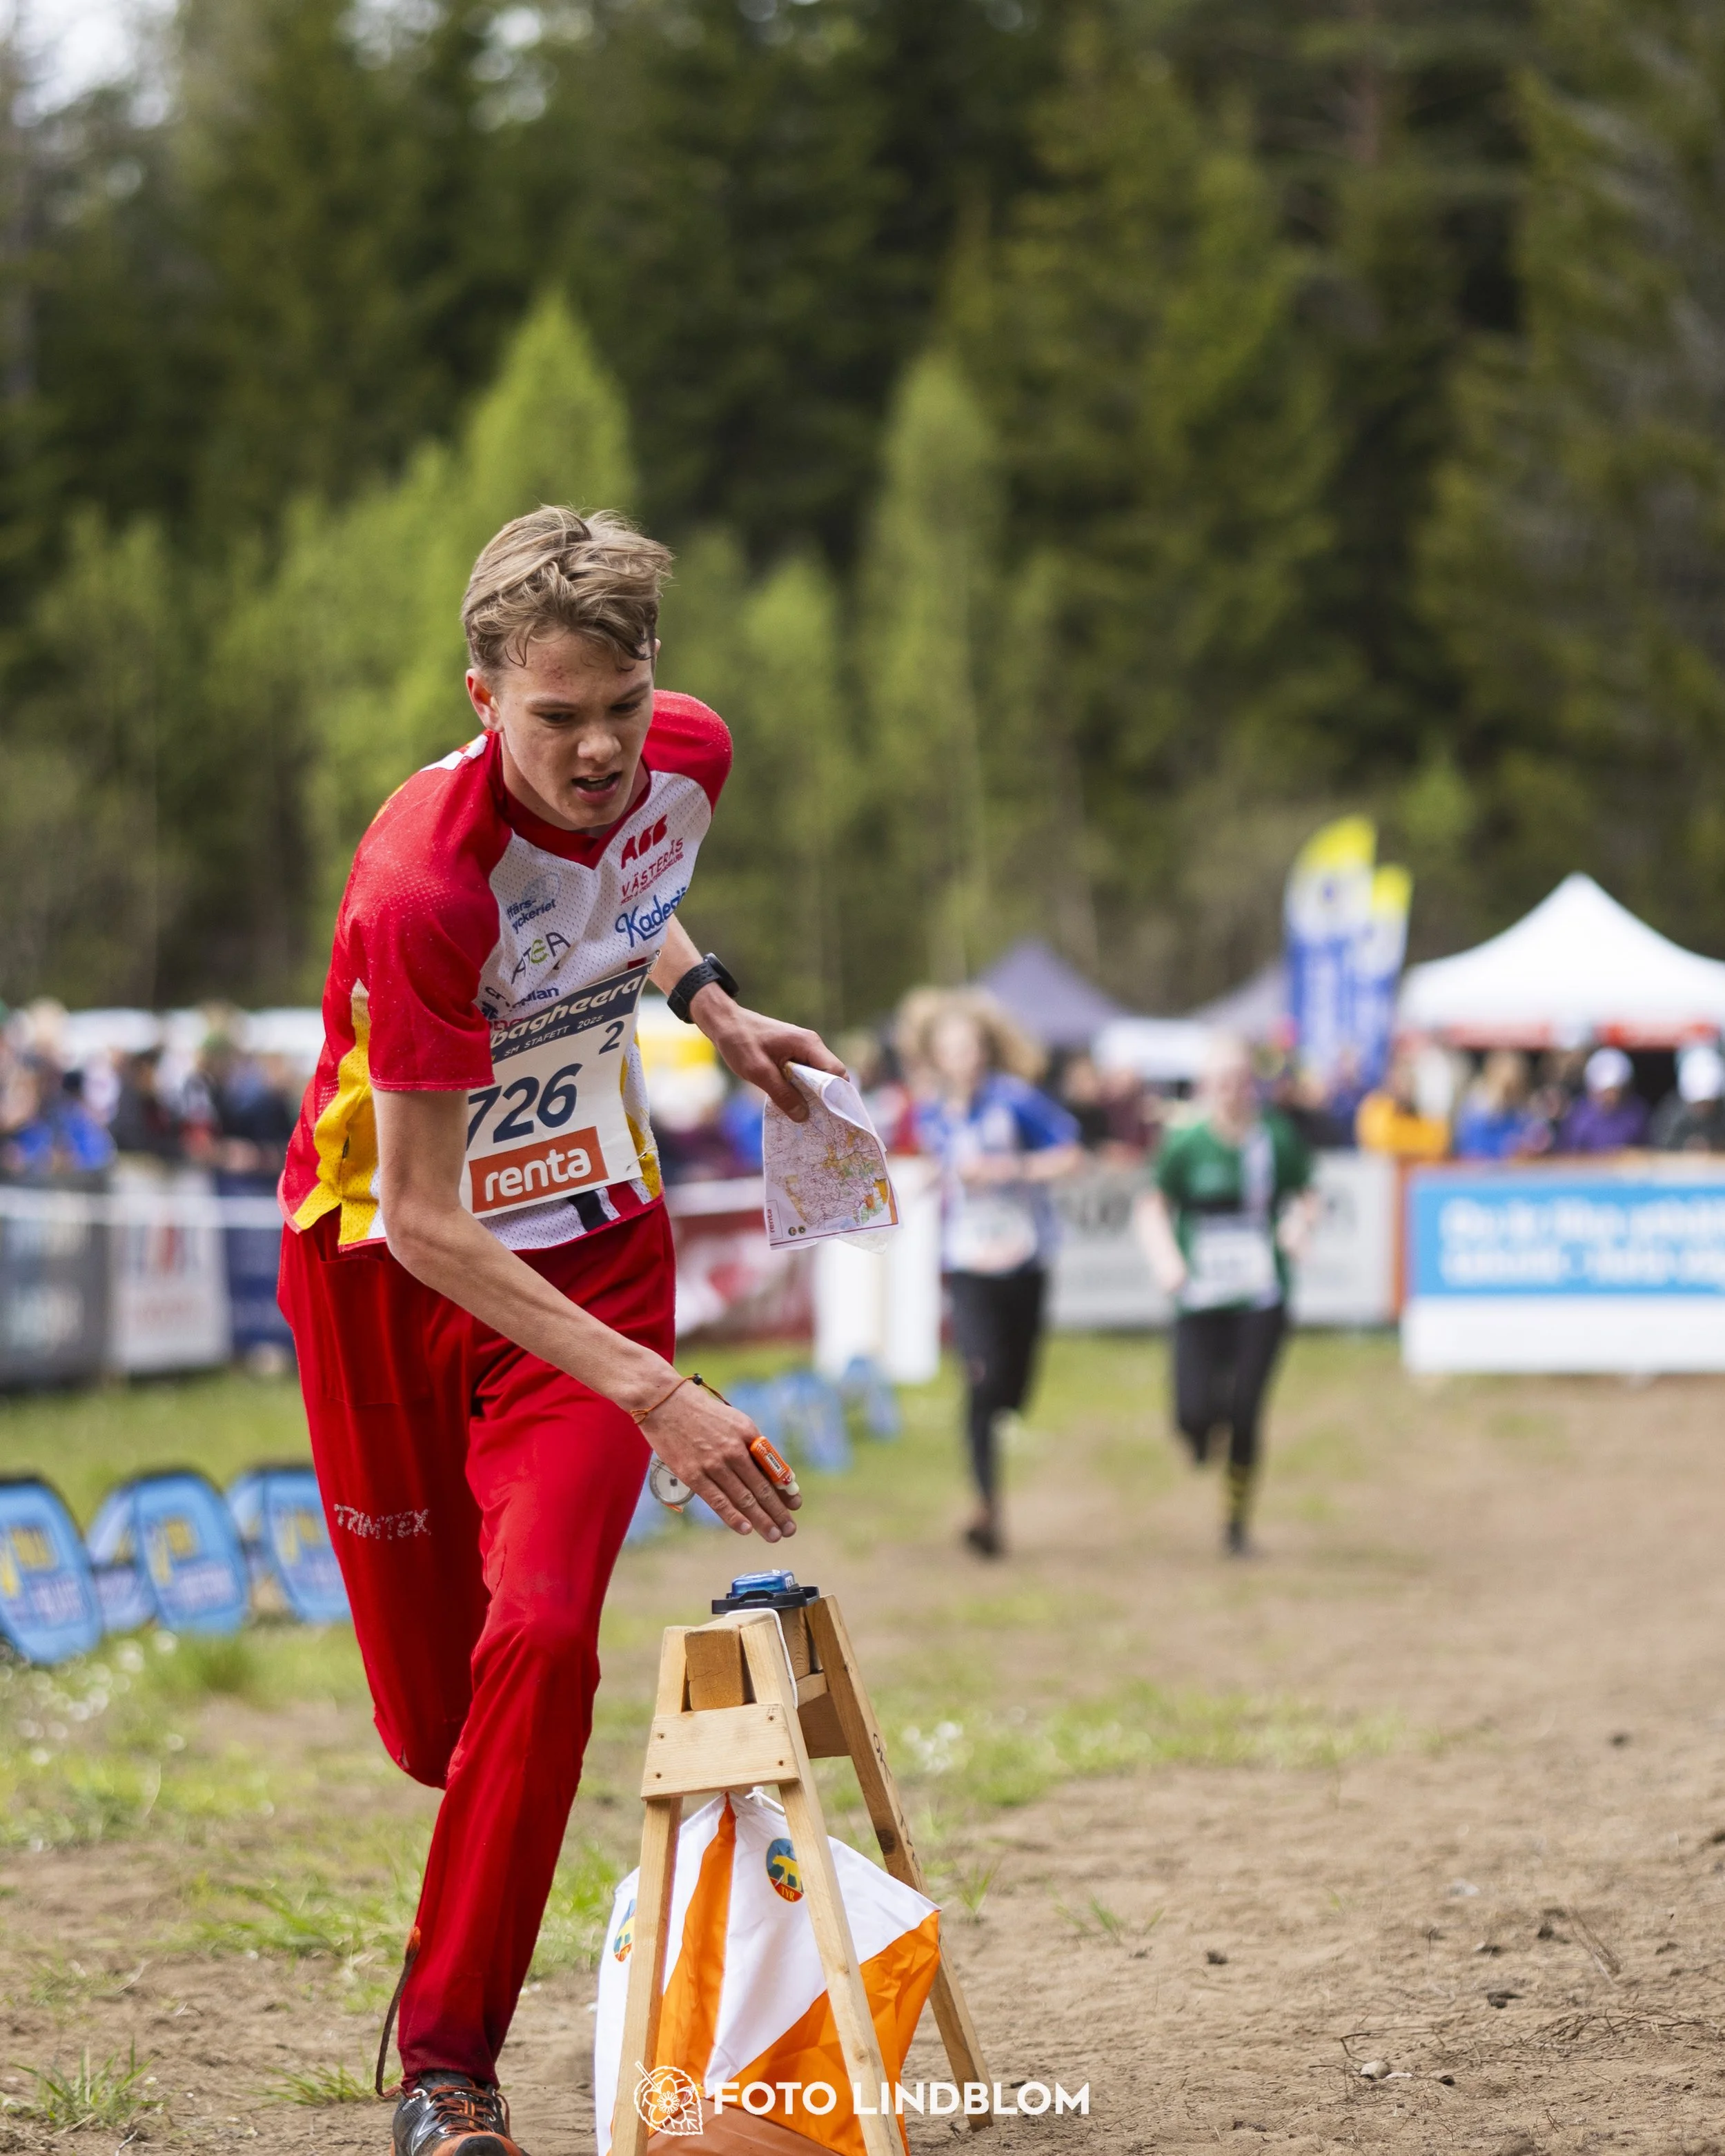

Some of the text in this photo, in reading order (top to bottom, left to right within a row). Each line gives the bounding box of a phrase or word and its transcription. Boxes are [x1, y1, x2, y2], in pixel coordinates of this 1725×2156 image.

[621, 814, 667, 869] ABB
[622, 838, 683, 896] VÄSTERÅS
[511, 932, 571, 985] ATEA
[491, 973, 640, 1049] bagheera
[504, 1014, 604, 1056] SM STAFETT 2025
[598, 1020, 625, 1055] 2
[466, 1063, 583, 1151] 726
[485, 1147, 592, 1202] renta
[767, 1209, 776, 1233] renta
[334, 1503, 432, 1540] TRIMTEX
[780, 1885, 795, 1902] TYR
